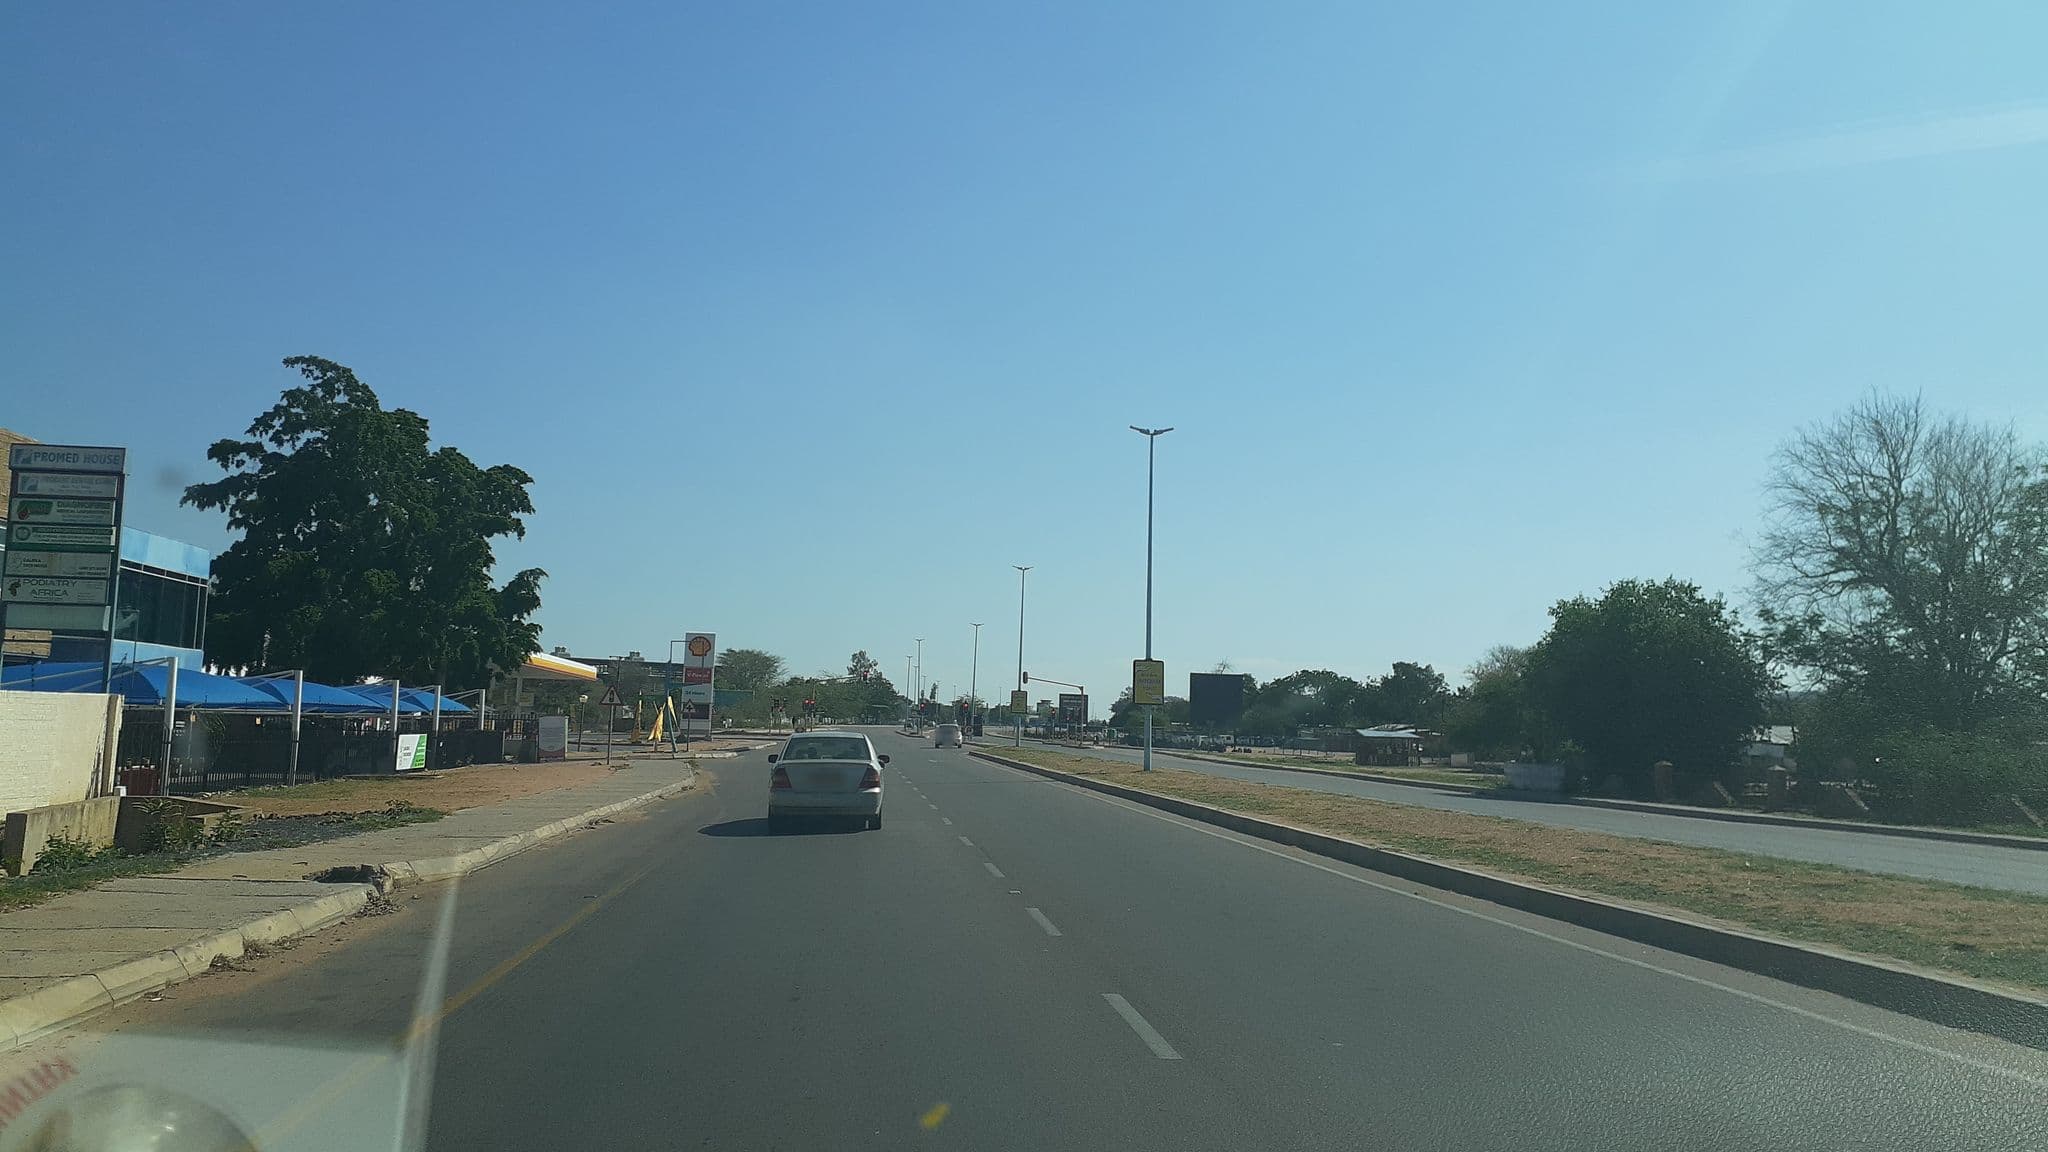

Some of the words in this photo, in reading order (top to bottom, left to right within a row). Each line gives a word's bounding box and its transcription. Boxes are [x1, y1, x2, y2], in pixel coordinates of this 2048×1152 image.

[34, 451, 79, 463] PROMED
[83, 454, 120, 465] HOUSE
[23, 579, 78, 588] PODIATRY
[31, 588, 69, 597] AFRICA
